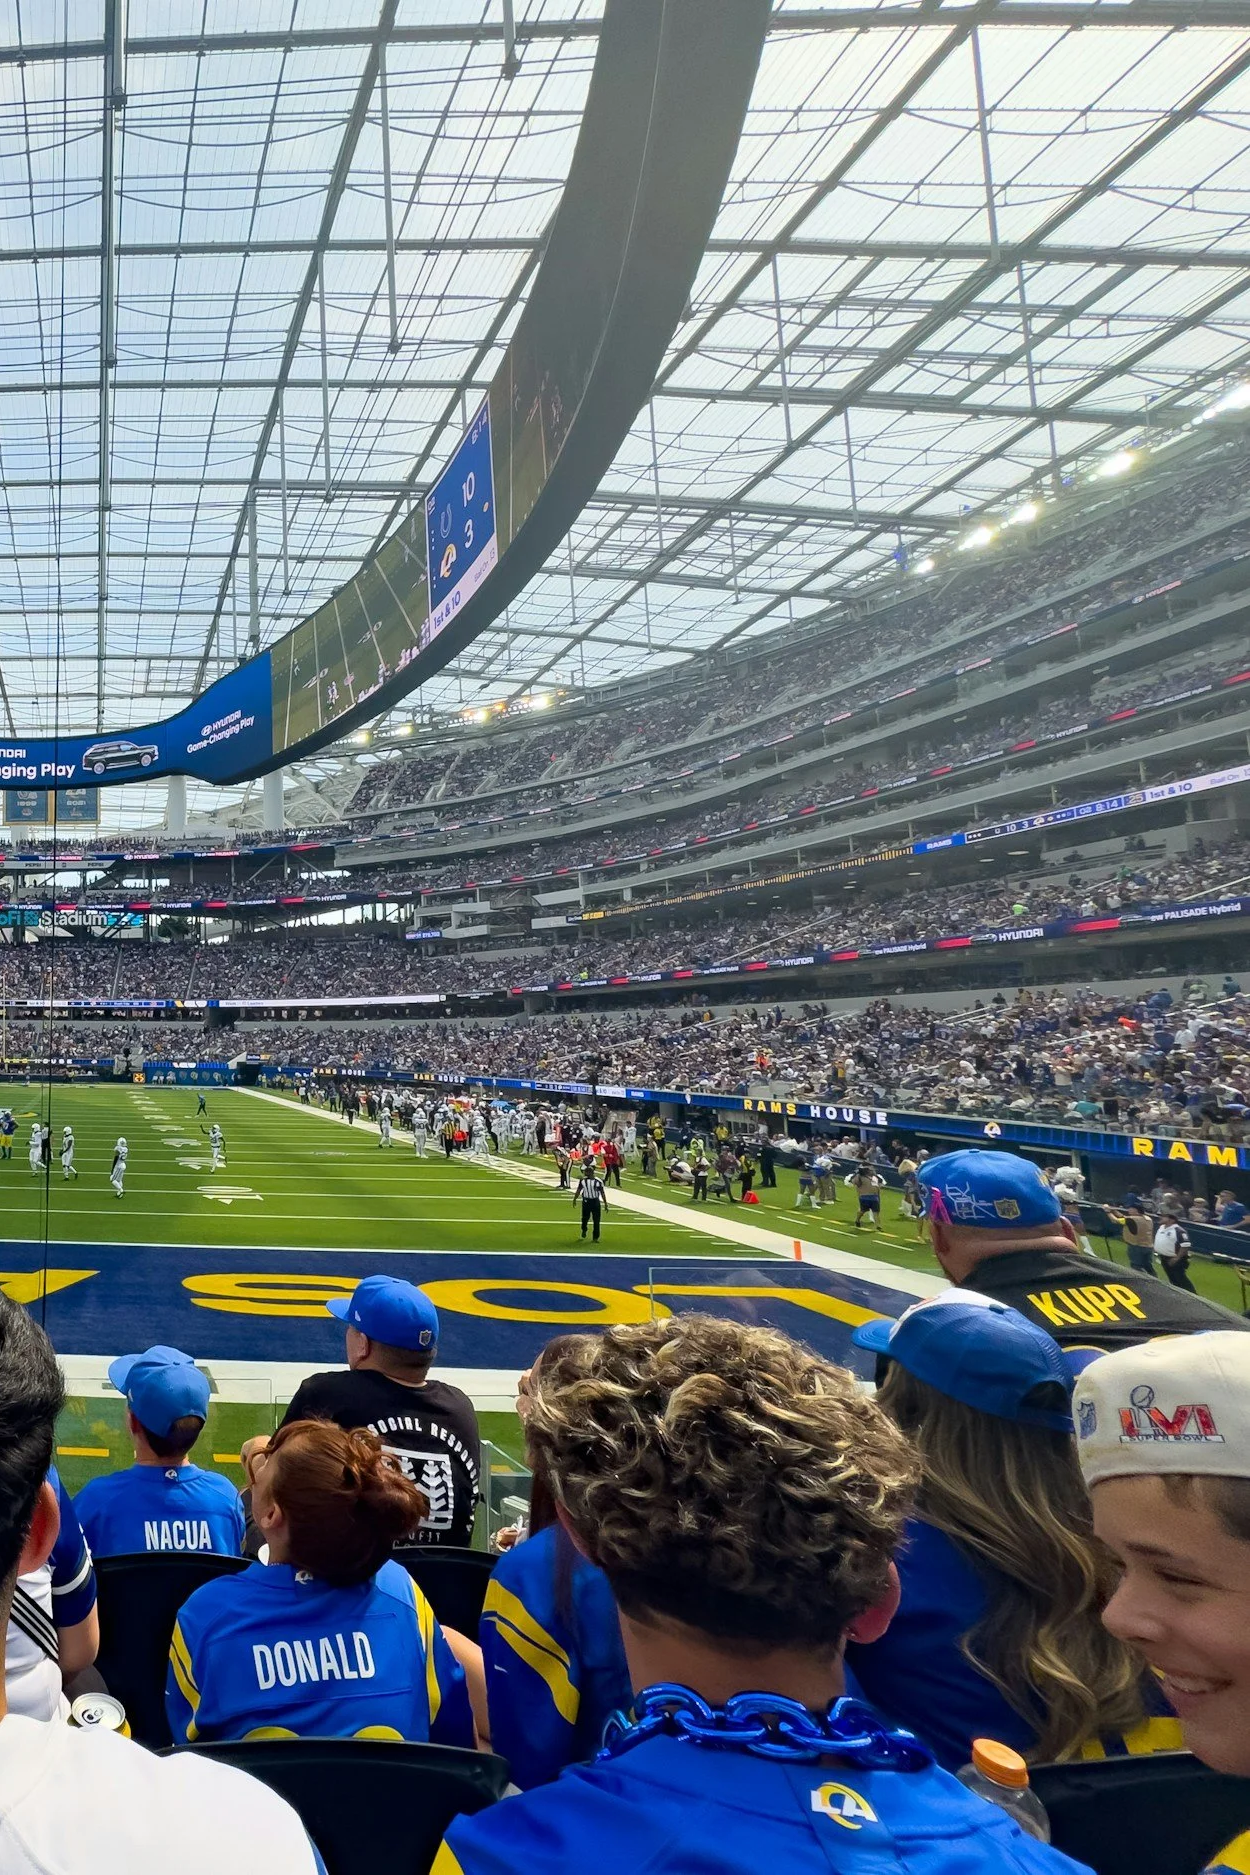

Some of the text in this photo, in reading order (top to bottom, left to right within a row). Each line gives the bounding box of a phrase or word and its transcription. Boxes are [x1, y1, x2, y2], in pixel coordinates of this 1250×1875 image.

[462, 471, 475, 507] 10
[465, 519, 474, 549] 3
[433, 590, 461, 631] 1st & 10
[212, 710, 242, 731] HYUNDAI
[1056, 723, 1088, 739] HYUNDAI
[186, 715, 255, 754] Game-Changing Play
[41, 763, 75, 778] Play
[1006, 823, 1017, 833] 10
[1022, 821, 1029, 829] 3
[1096, 800, 1119, 813] 8:14
[1127, 794, 1143, 804] 25
[1149, 790, 1166, 800] 1st
[1167, 787, 1176, 796] &
[1178, 782, 1193, 793] 10
[926, 839, 952, 850] RAMS
[321, 894, 347, 902] HYUNDAI
[42, 911, 106, 926] Stadium
[1164, 907, 1208, 921] PALISADE
[1209, 903, 1242, 915] Hybrid
[998, 928, 1044, 942] HYUNDAI
[784, 956, 814, 967] HYUNDAI
[414, 1073, 465, 1084] RAMS HOUSE
[744, 1098, 888, 1126] RAMS HOUSE
[1132, 1137, 1238, 1168] RAM
[1027, 1284, 1147, 1327] KUPP
[367, 1416, 423, 1438] SOCIAL
[144, 1520, 212, 1551] NACUA
[253, 1631, 376, 1690] DONALD
